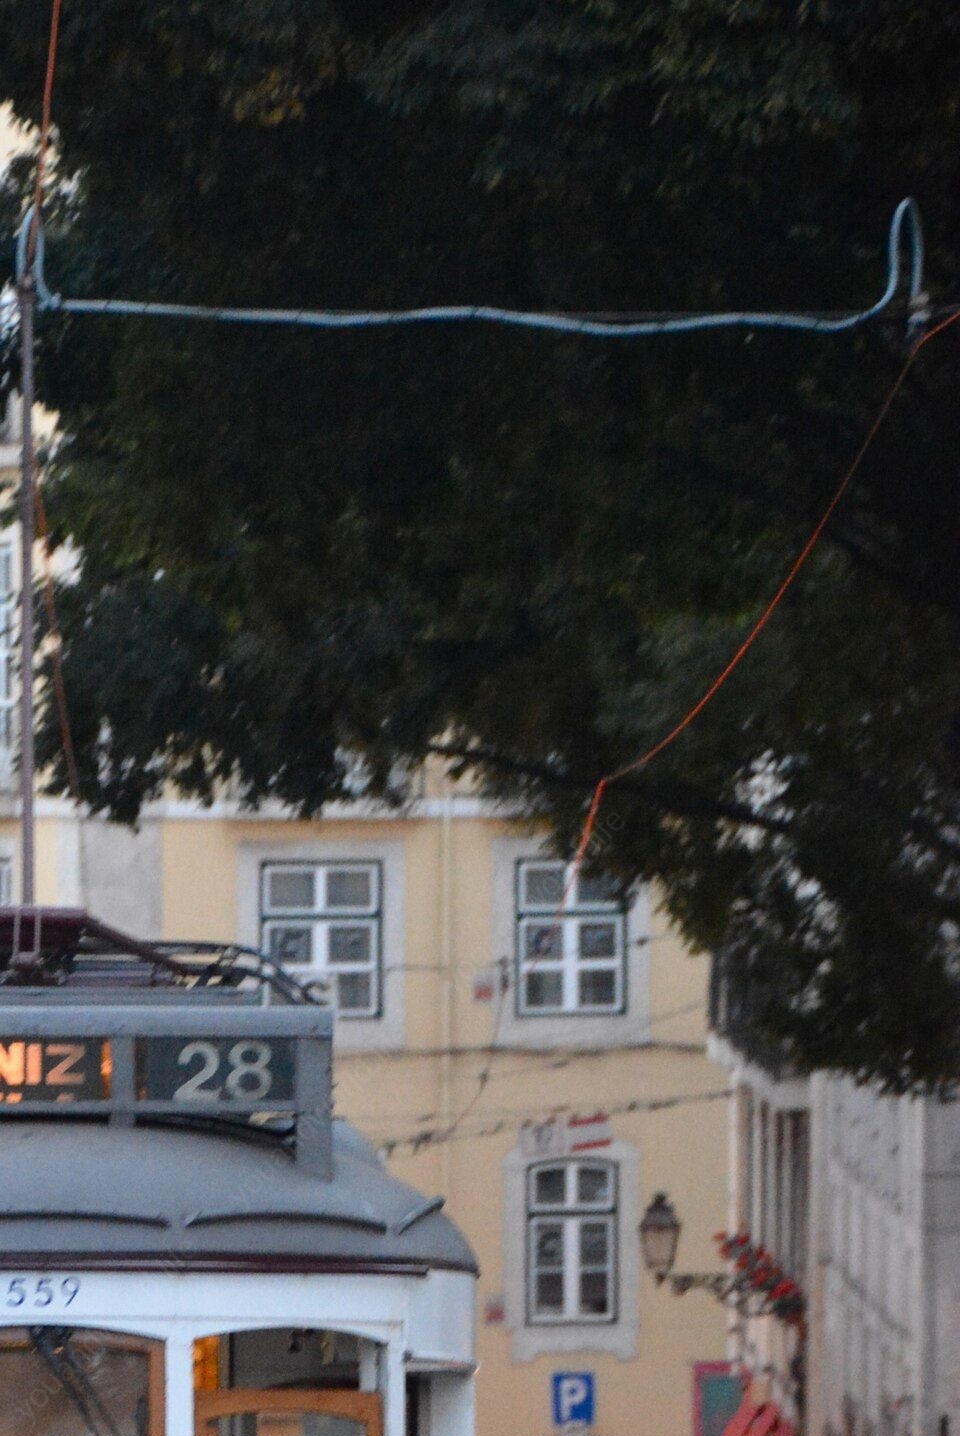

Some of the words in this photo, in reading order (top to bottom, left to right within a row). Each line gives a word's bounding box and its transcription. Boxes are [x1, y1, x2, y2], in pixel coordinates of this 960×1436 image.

[172, 1039, 273, 1102] 28
[6, 1275, 81, 1308] 559
[559, 1377, 587, 1422] P
